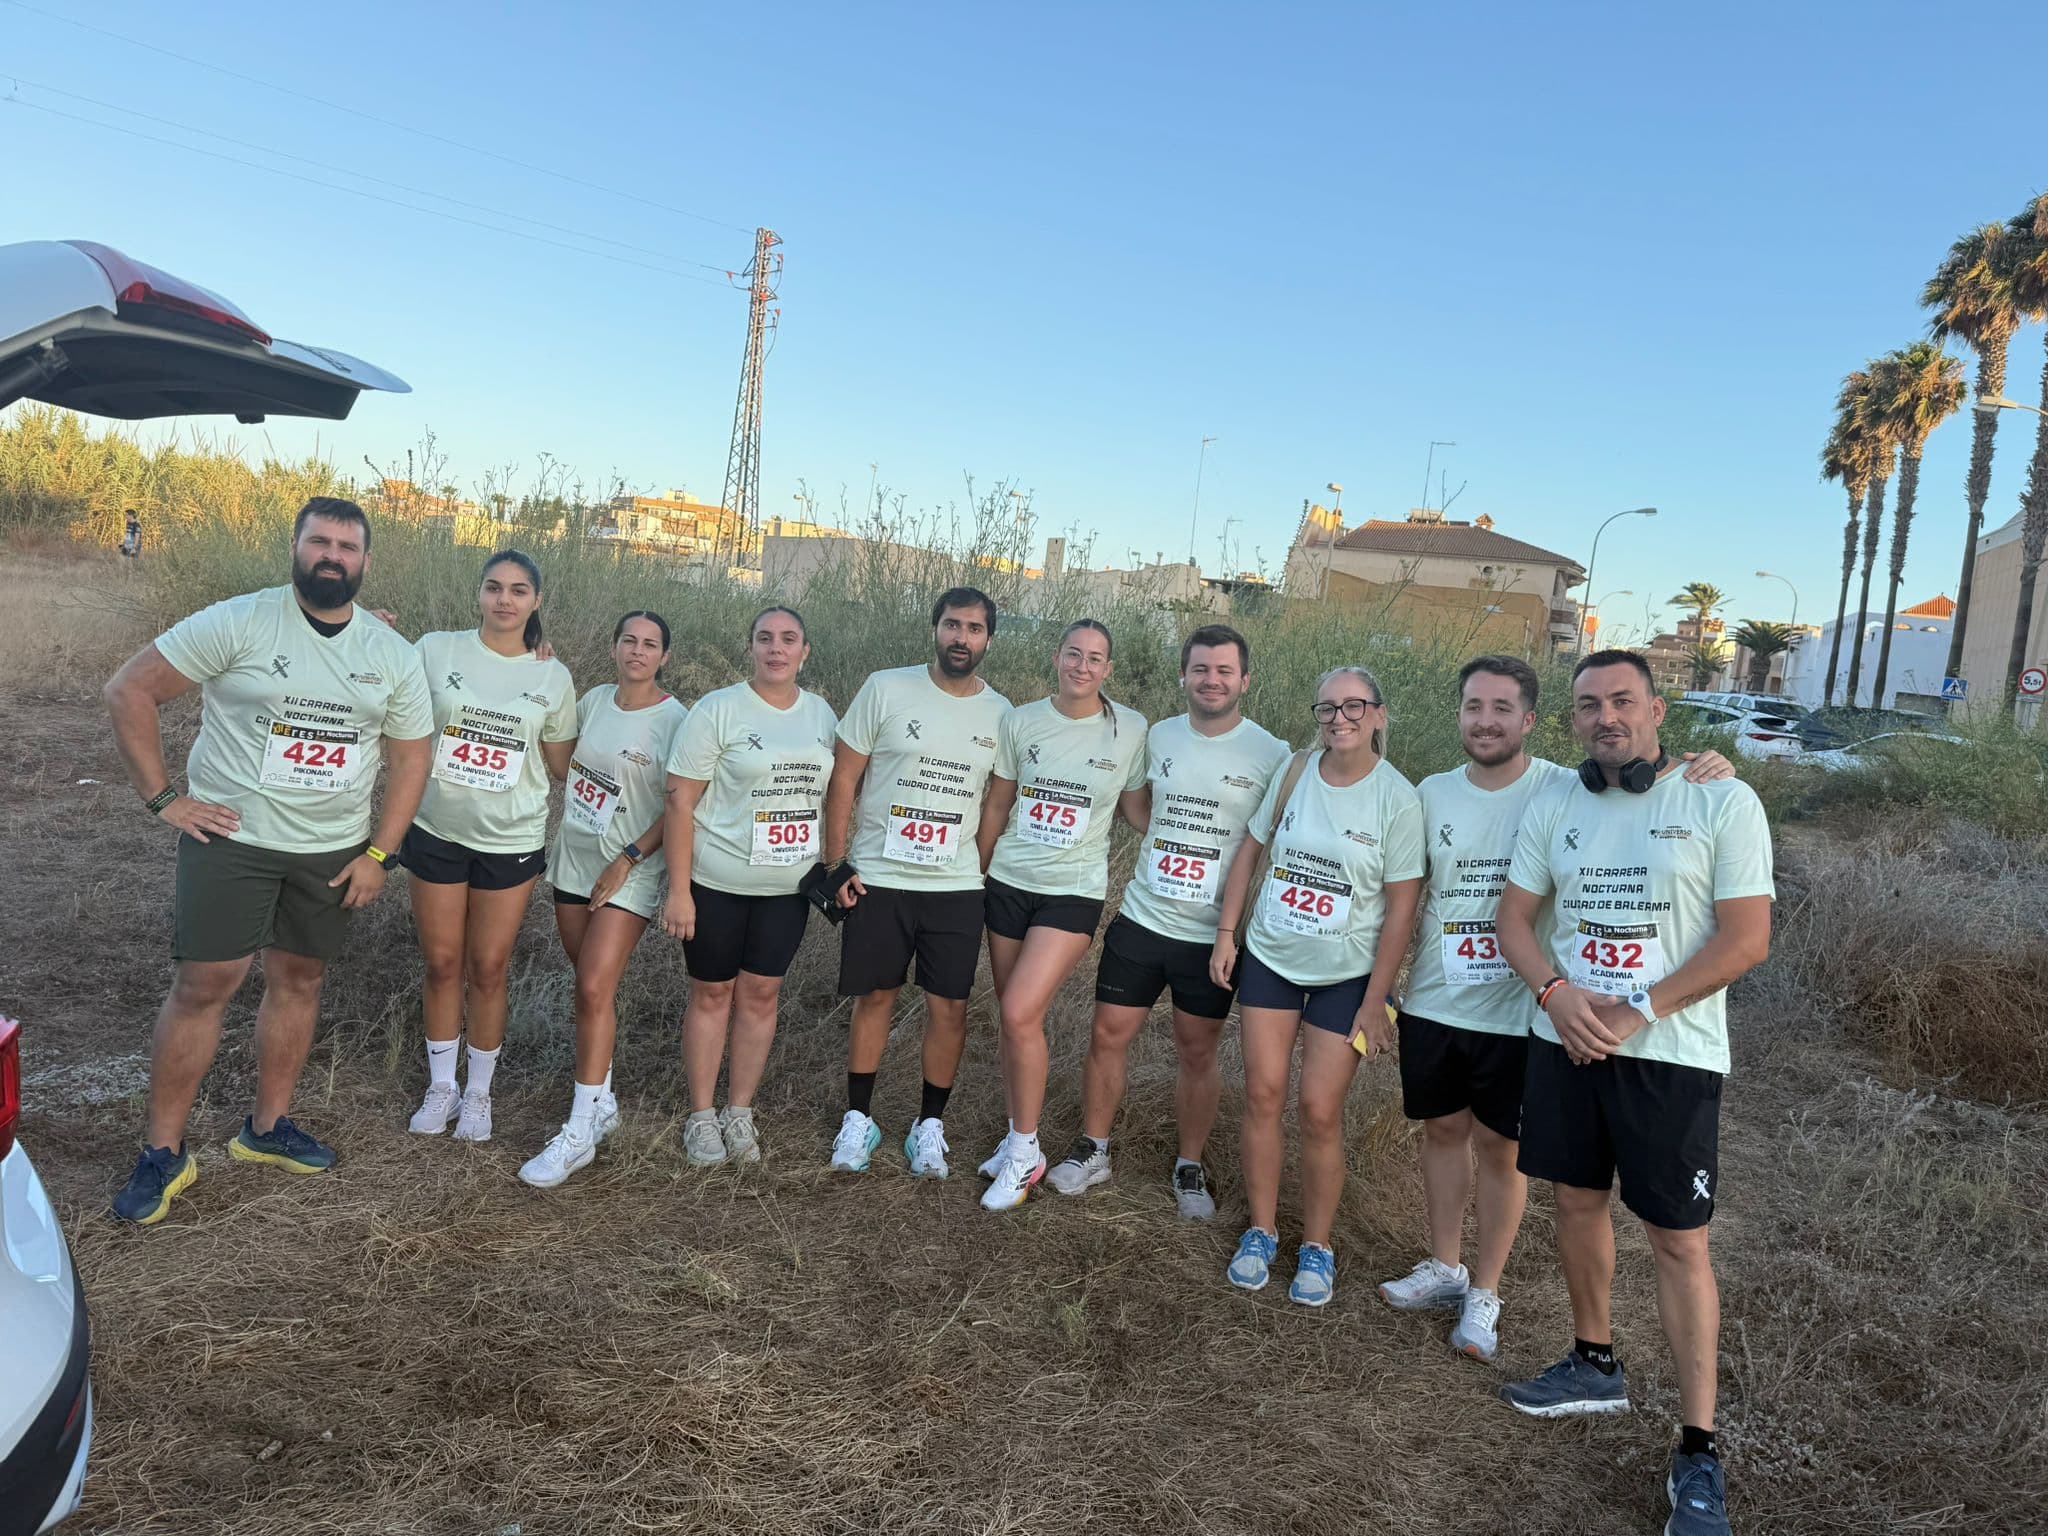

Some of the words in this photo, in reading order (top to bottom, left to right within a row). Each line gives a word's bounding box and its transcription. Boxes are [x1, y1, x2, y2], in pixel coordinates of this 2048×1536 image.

[283, 696, 298, 705] XII
[298, 698, 353, 714] CARRERA
[284, 711, 344, 726] NOCTURNA
[461, 705, 474, 714] XII
[474, 708, 521, 724] CARRERA
[461, 719, 514, 736] NOCTURNA
[283, 741, 346, 768] 424
[452, 743, 508, 770] 435
[447, 762, 460, 771] BEA
[463, 765, 496, 778] UNIVERSO
[783, 763, 822, 772] CARRERA
[918, 756, 932, 764] XII
[932, 758, 971, 772] CARRERA
[293, 767, 333, 777] PIKONAKO
[920, 769, 964, 784] NOCTURNA
[773, 776, 815, 784] NOCTURNA
[1034, 777, 1045, 785] XII
[1046, 779, 1087, 792] CARRERA
[574, 778, 607, 811] 451
[752, 788, 783, 798] CIUDAD
[793, 788, 823, 797] BALERM
[897, 778, 929, 790] CIUDAD
[930, 783, 941, 793] DE
[942, 786, 974, 799] BALERM
[1177, 795, 1219, 809] CARRERA
[1029, 802, 1077, 828] 475
[1167, 806, 1213, 821] NOCTURNA
[768, 824, 810, 845] 503
[900, 822, 948, 845] 491
[1050, 826, 1072, 836] BIANCA
[1177, 821, 1188, 830] DE
[1188, 823, 1231, 837] BALERMA
[772, 845, 799, 853] UNIVERSO
[1285, 848, 1295, 857] XII
[1296, 852, 1341, 871] CARRERA
[1456, 860, 1469, 868] XII
[1470, 858, 1511, 868] CARRER
[1157, 855, 1205, 881] 425
[1579, 867, 1593, 877] XII
[1596, 867, 1647, 877] CARRERA
[1186, 881, 1202, 890] ALIN
[1460, 874, 1506, 883] NOCTURN
[1440, 889, 1471, 899] CIUDAD
[1473, 889, 1485, 897] DE
[1582, 884, 1643, 894] NOCTURNA
[1280, 886, 1334, 917] 426
[1598, 901, 1611, 910] DE
[1614, 900, 1671, 912] BALERMA
[1289, 911, 1319, 924] PATRICIA
[1614, 926, 1648, 934] Nocturna
[1457, 936, 1498, 960] 43
[1581, 939, 1644, 968] 432
[1466, 961, 1508, 970] JAVIERRS9
[1590, 969, 1633, 980] ACADEMIA
[1588, 1350, 1611, 1362] FILA
